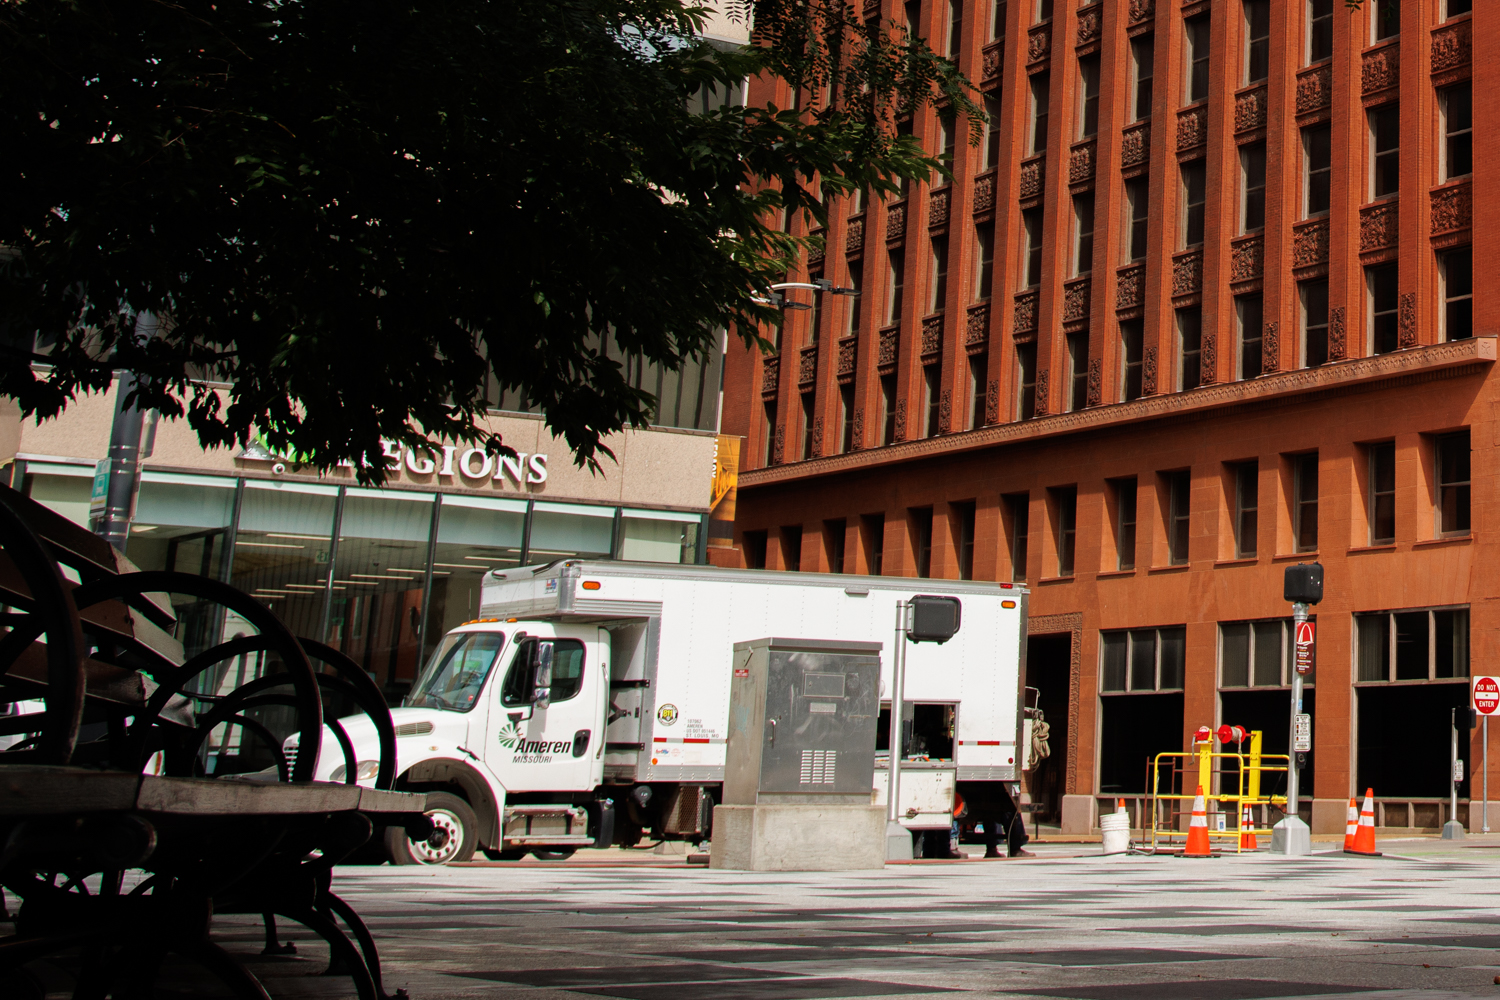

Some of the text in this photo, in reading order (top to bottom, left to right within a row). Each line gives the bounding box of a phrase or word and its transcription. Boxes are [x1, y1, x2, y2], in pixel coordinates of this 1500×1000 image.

[1479, 700, 1495, 708] ENTER
[663, 709, 673, 718] 811
[513, 738, 571, 753] Ameren
[512, 755, 552, 763] MISSOURI
